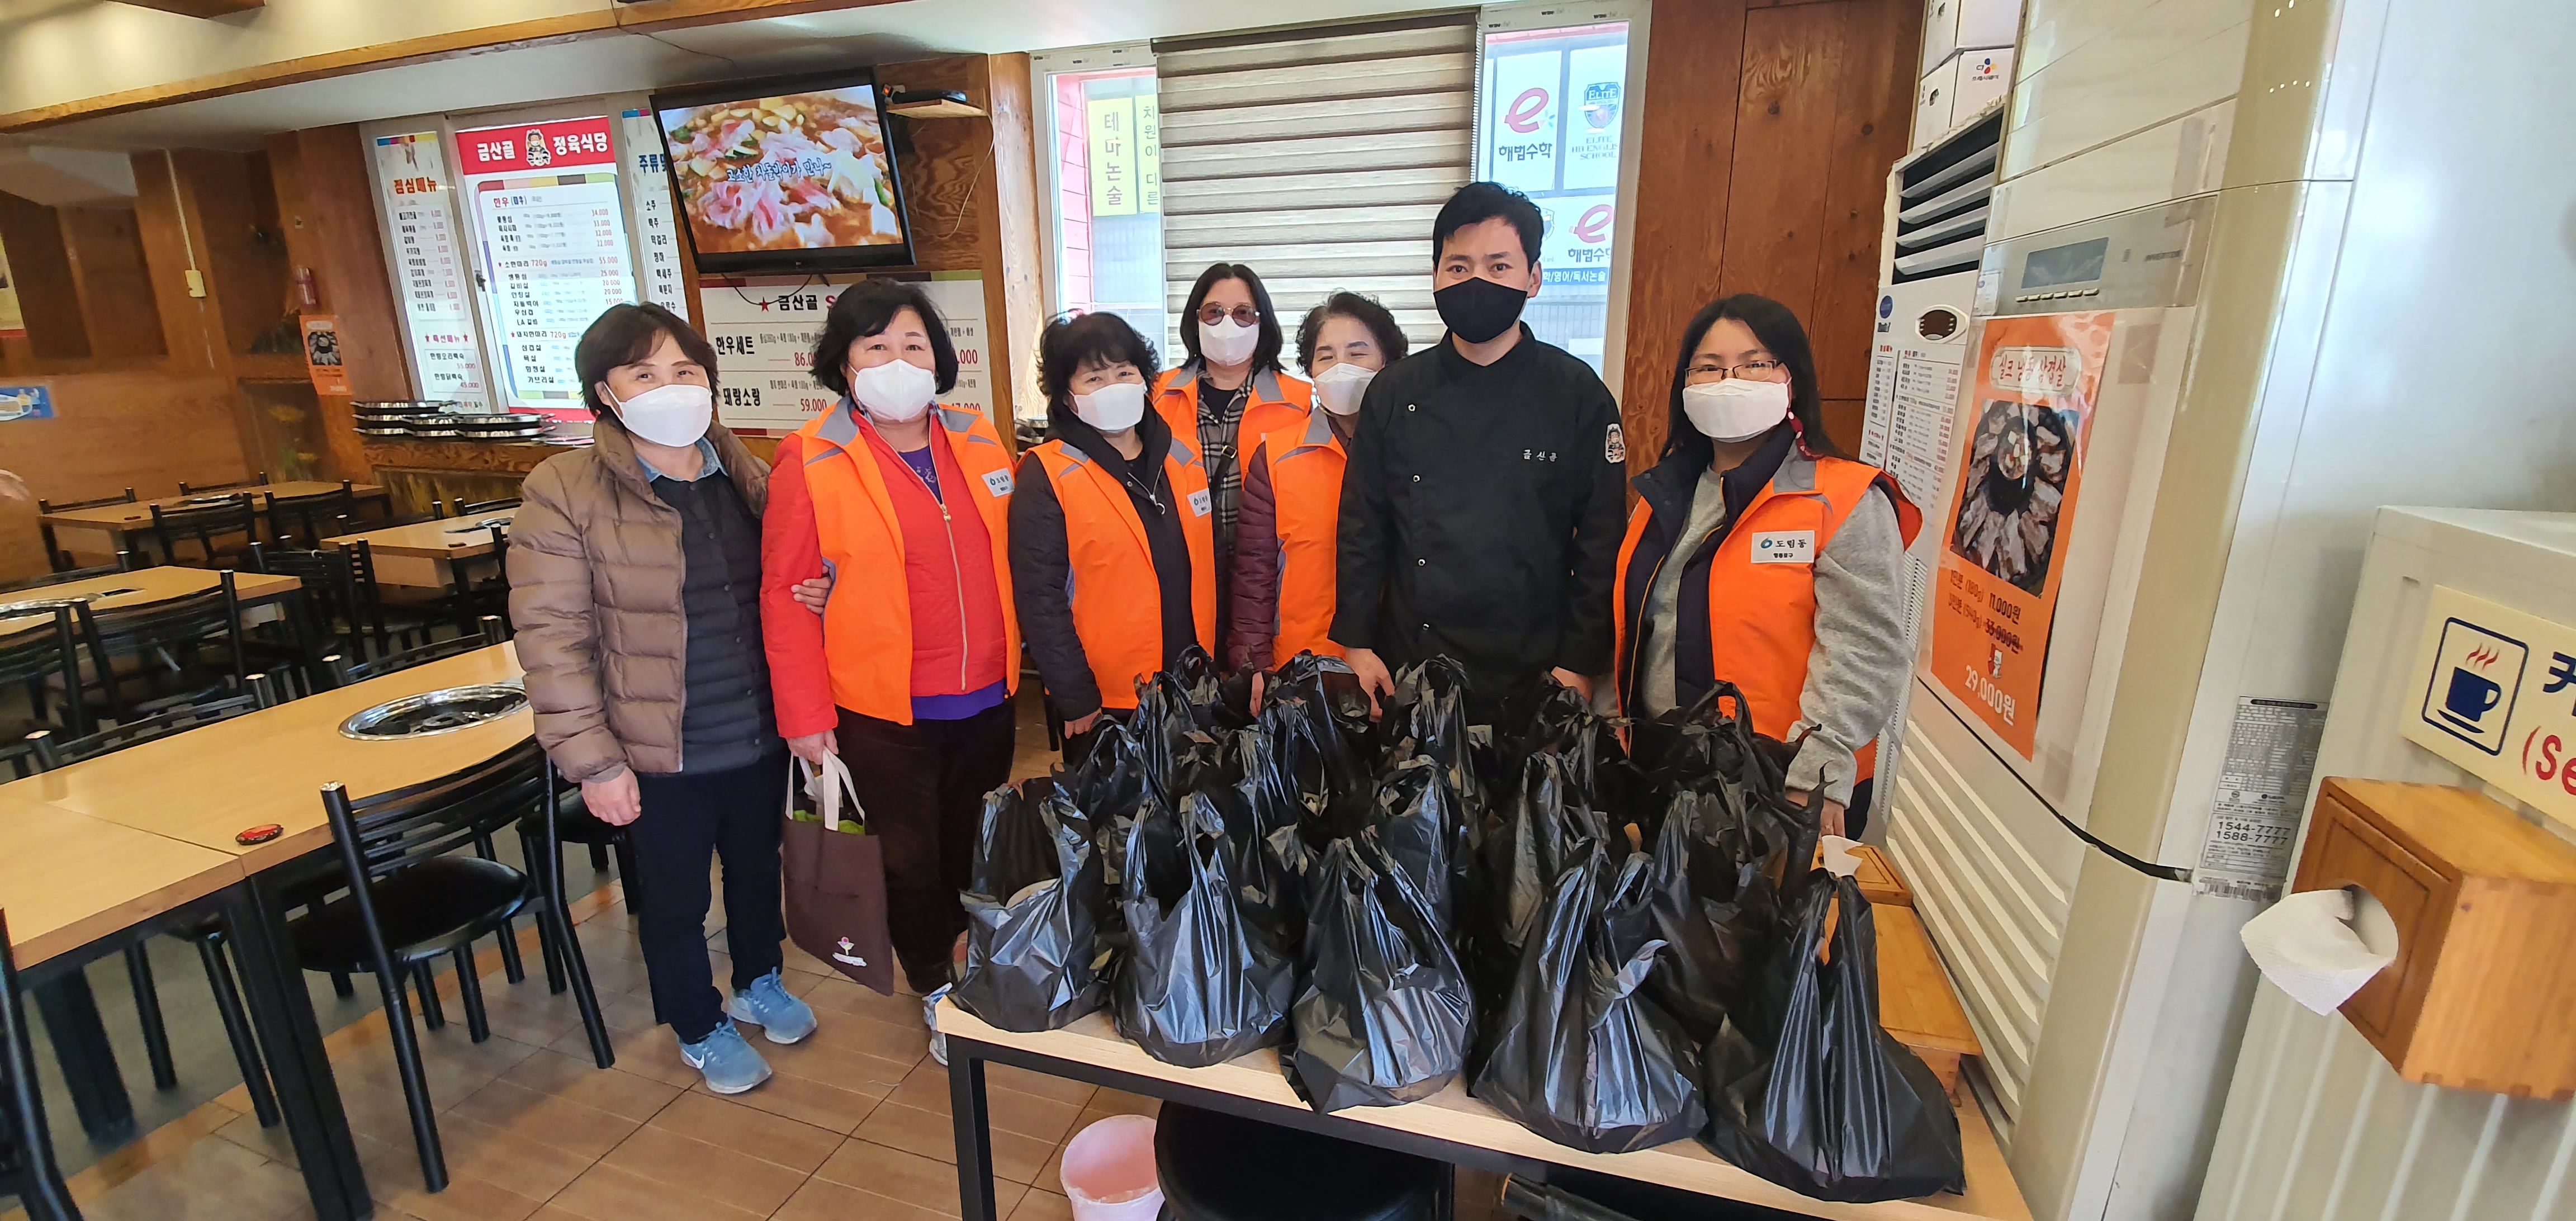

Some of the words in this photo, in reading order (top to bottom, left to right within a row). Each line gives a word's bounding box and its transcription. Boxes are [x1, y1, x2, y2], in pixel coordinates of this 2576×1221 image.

[1588, 88, 1617, 100] ELITE
[477, 140, 516, 162] 금산골
[552, 131, 608, 156] 정육식당
[1586, 135, 1613, 144] ELITE
[1104, 111, 1123, 206] 테마논술
[1498, 141, 1553, 162] 해법수학
[1580, 150, 1617, 160] SCHOOL
[726, 164, 754, 183] 고소한
[394, 177, 437, 195] 점심메뉴
[646, 200, 656, 211] 소주
[531, 259, 548, 268] 720g
[599, 256, 618, 264] 55.000
[778, 294, 818, 311] 금산골
[716, 335, 755, 355] 한우세트
[801, 398, 827, 412] 59.000
[1964, 665, 2016, 727] 29,000원
[2218, 821, 2291, 834] 1544-7777
[2215, 830, 2288, 845] 1588-7777
